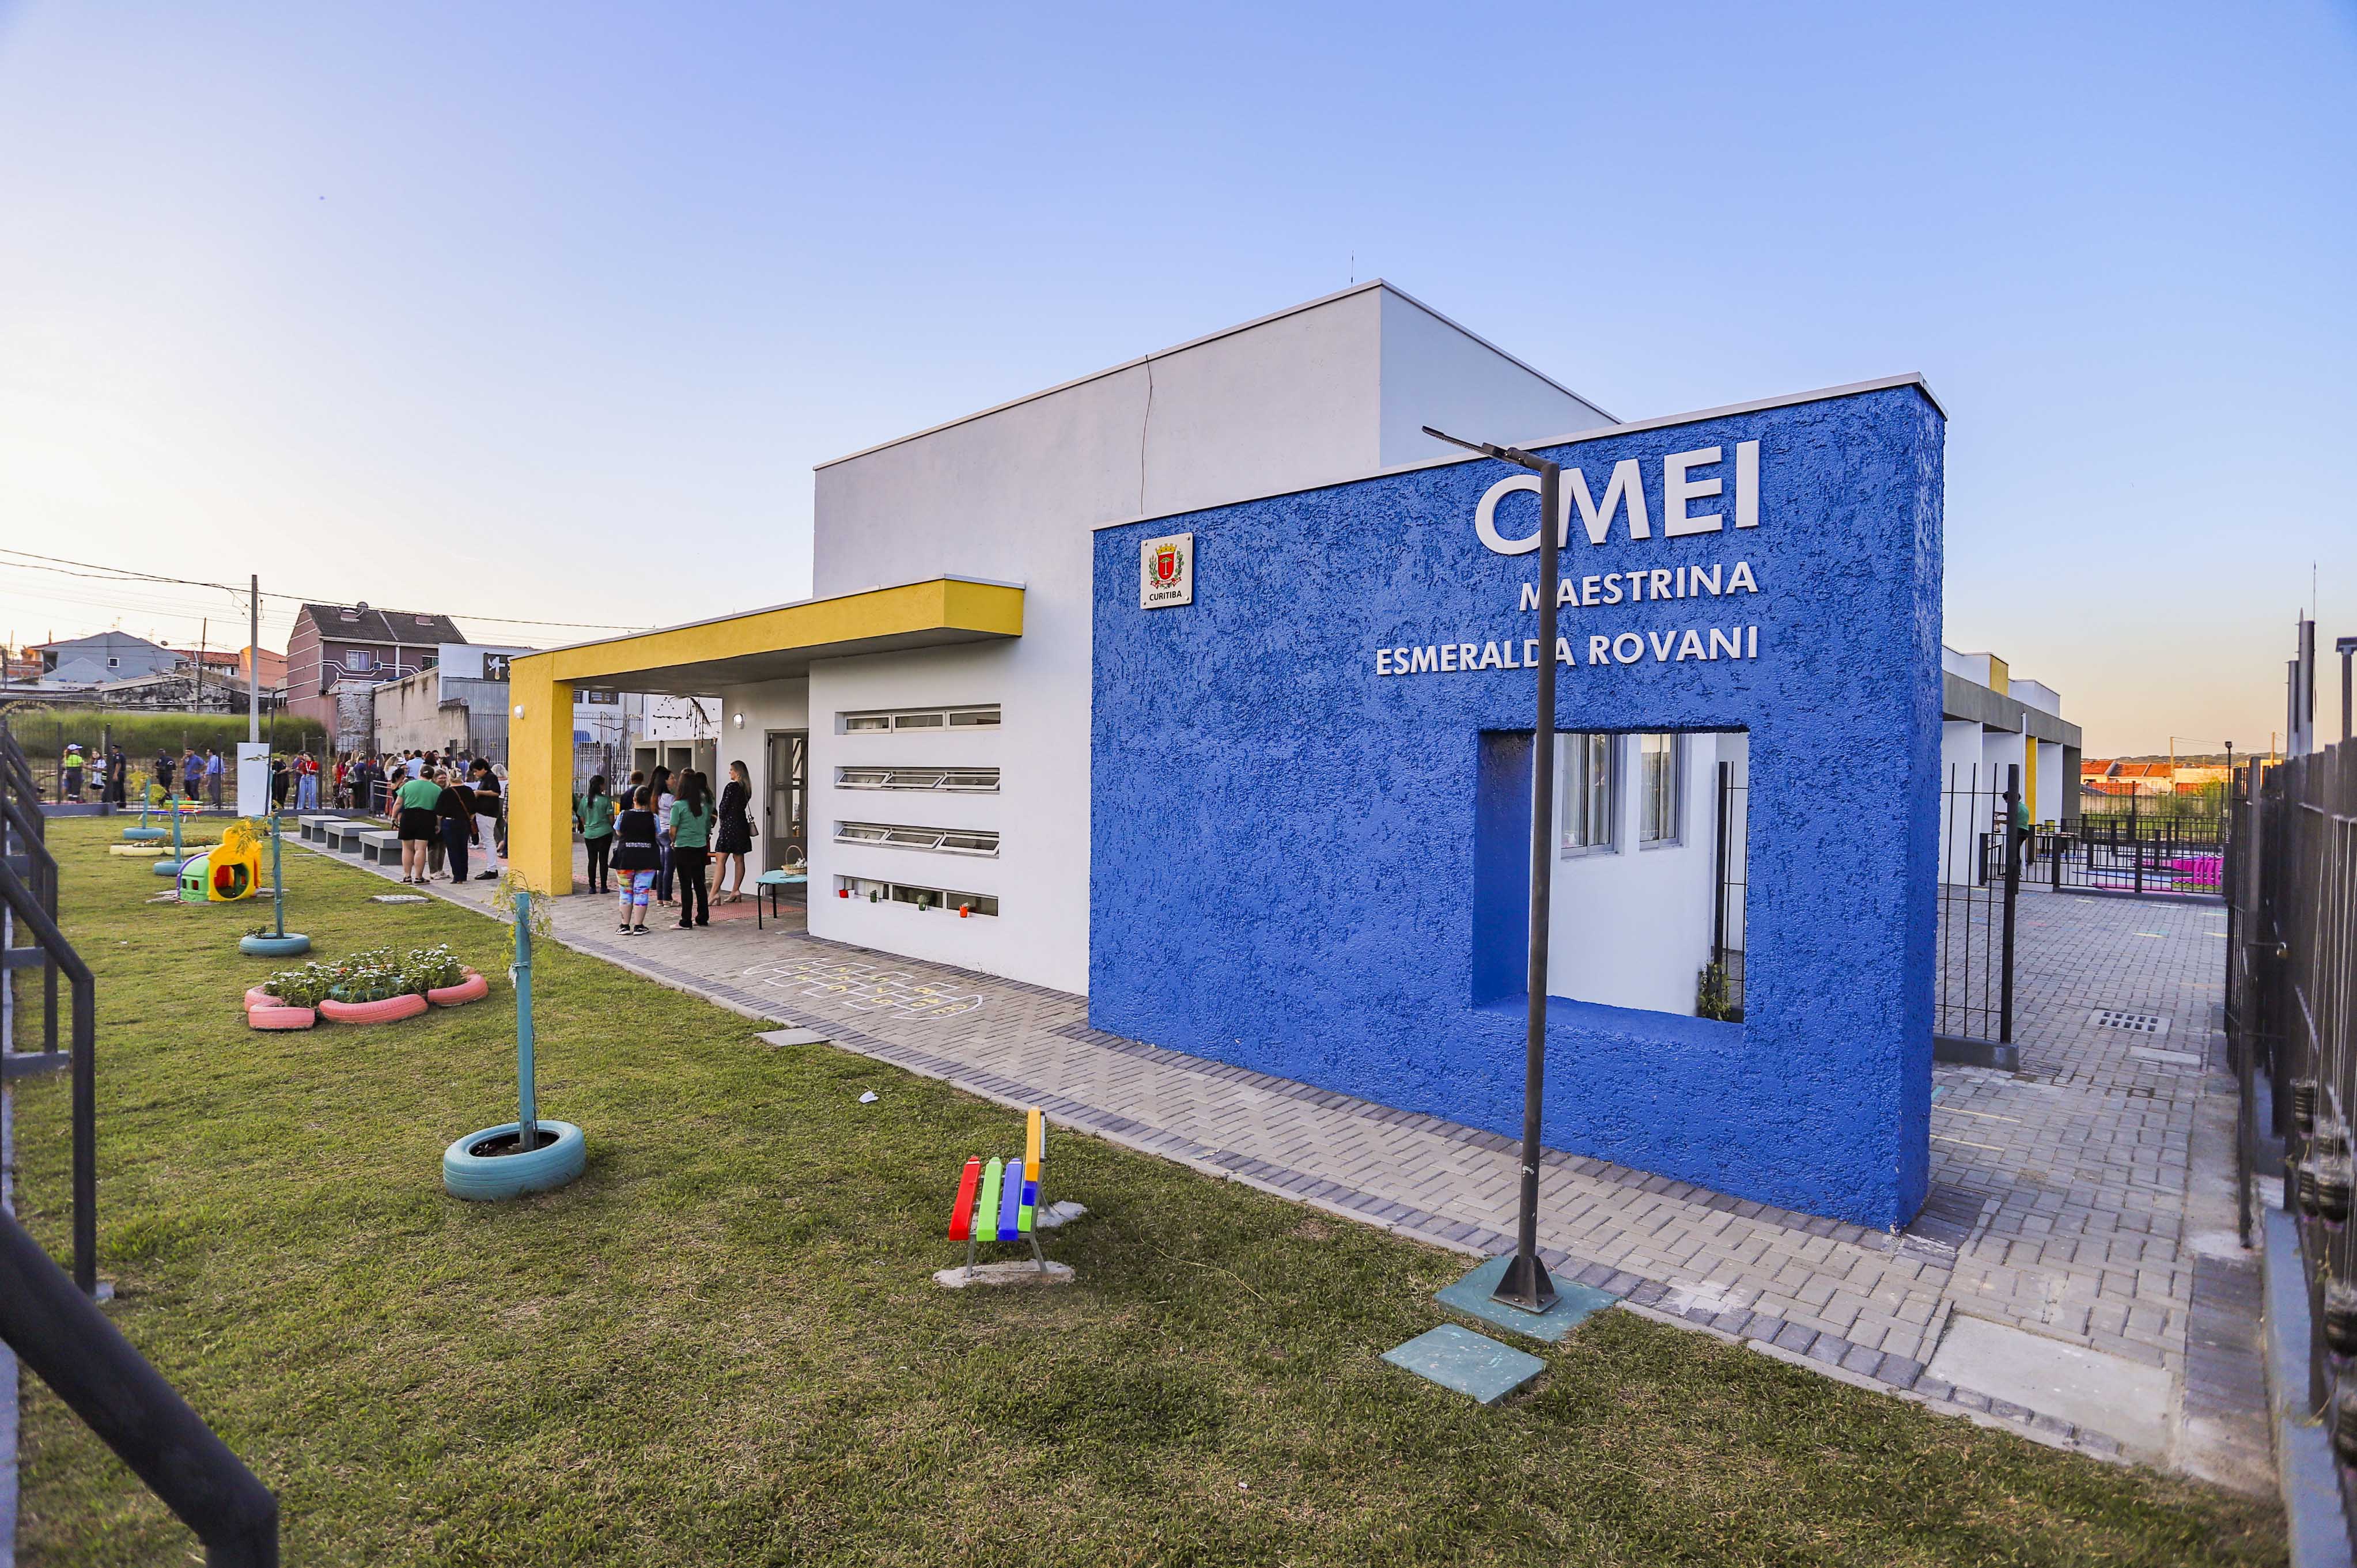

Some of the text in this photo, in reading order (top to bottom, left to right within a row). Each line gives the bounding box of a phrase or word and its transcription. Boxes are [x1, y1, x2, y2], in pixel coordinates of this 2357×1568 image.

[1474, 440, 1759, 555] CMEI
[1149, 590, 1182, 601] CURITIBA
[1519, 560, 1758, 611] MAESTRINA
[1376, 626, 1758, 675] ESMERALDA ROVANI
